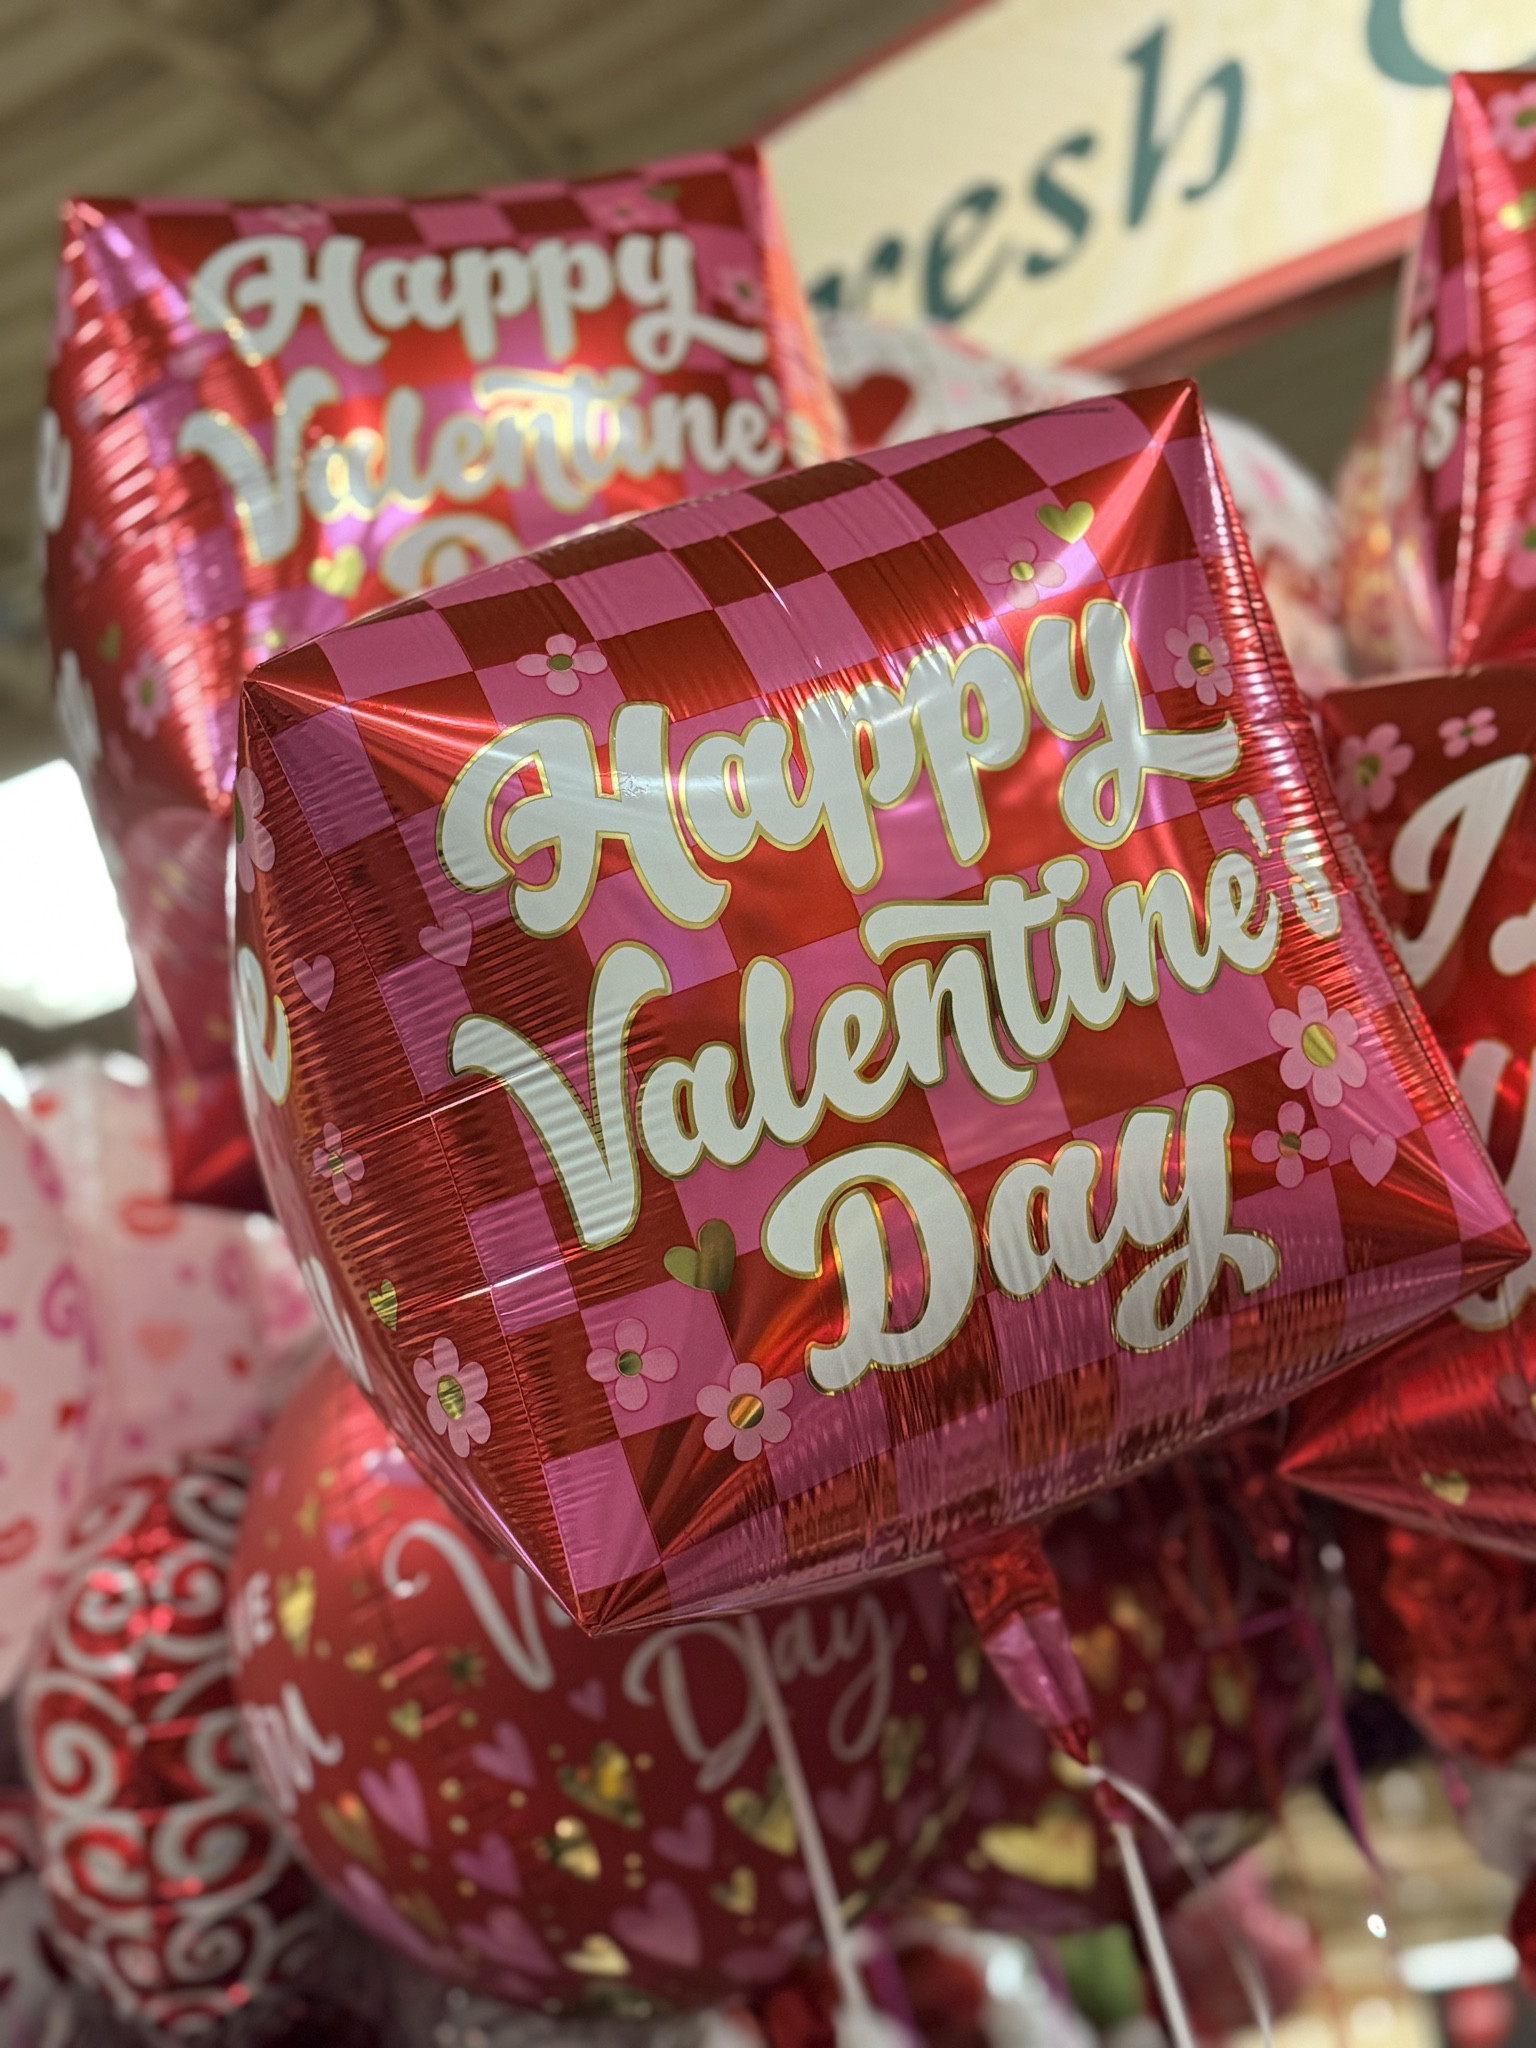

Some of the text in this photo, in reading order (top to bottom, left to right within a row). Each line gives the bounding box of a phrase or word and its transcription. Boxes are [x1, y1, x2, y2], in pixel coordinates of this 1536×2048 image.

[188, 233, 768, 372] Happy
[436, 598, 1242, 938] Happy
[448, 794, 1341, 1250] Valentine's
[761, 1083, 1281, 1395] Day
[622, 1594, 906, 1792] Day
